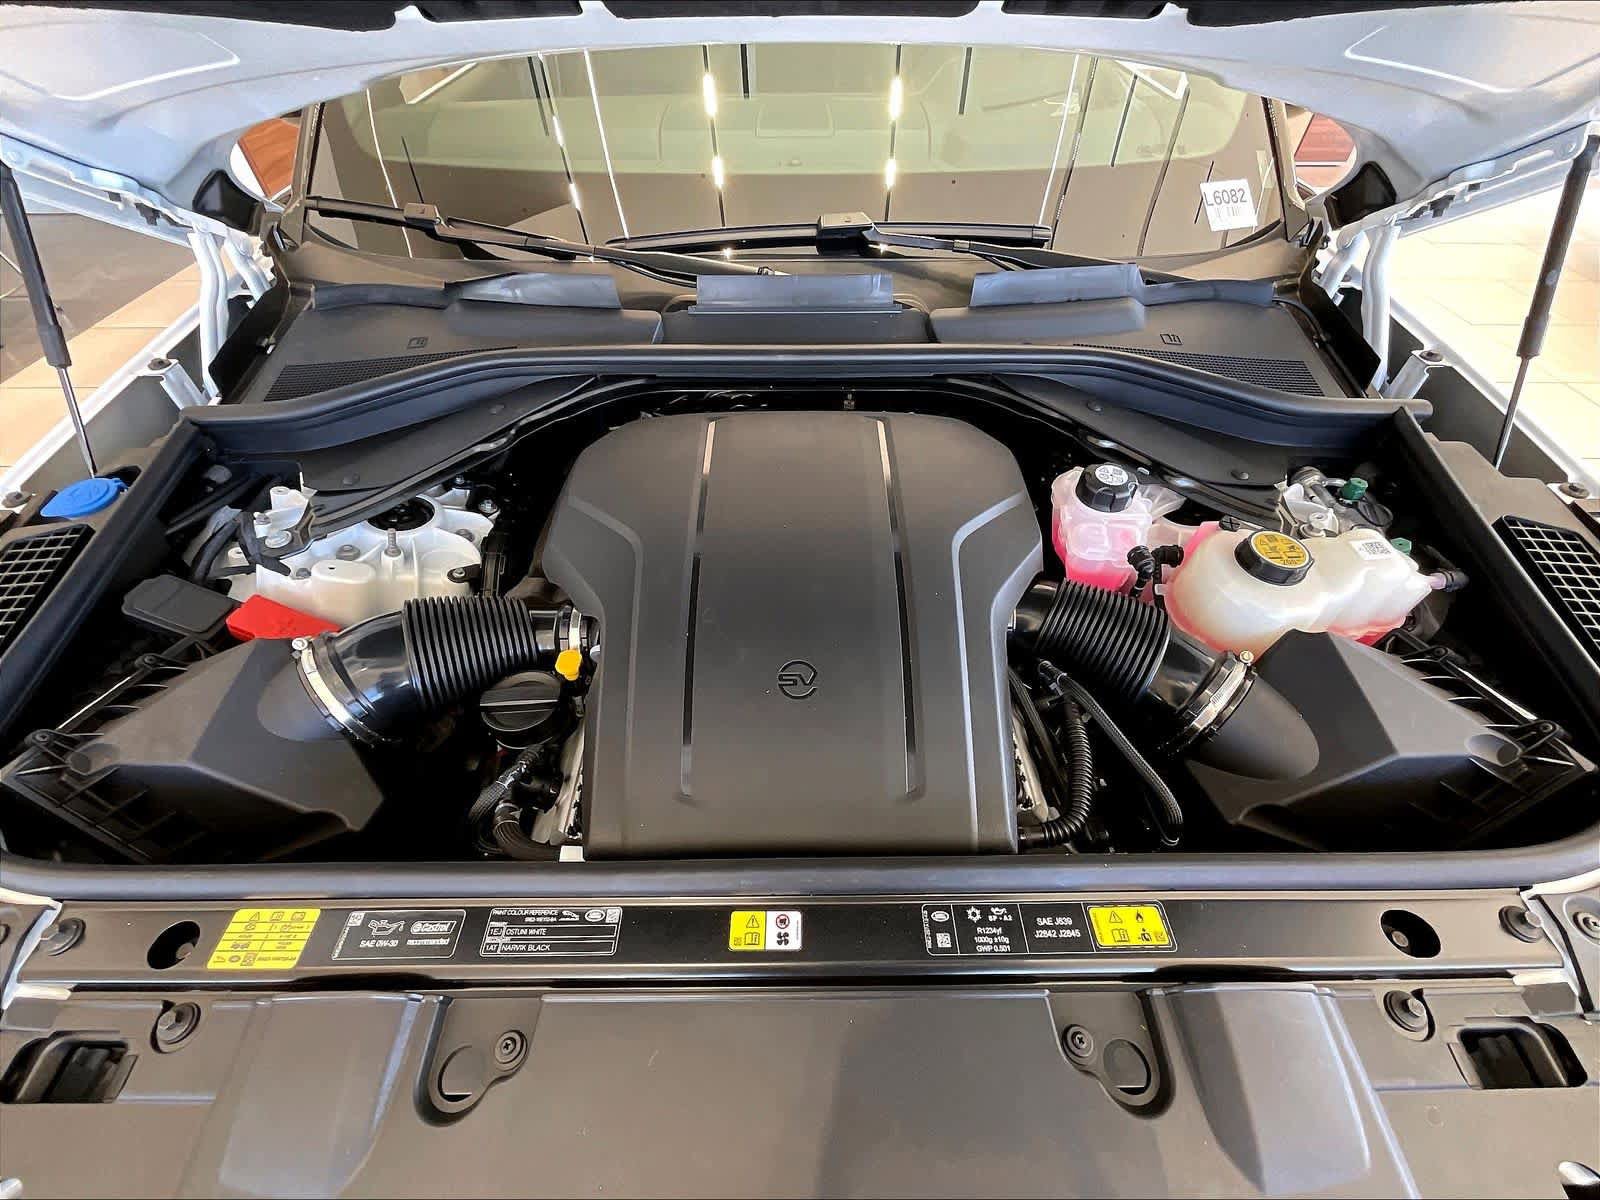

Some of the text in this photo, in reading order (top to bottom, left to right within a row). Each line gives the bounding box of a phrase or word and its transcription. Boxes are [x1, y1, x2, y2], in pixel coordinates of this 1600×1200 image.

[1203, 188, 1247, 206] L6082
[1036, 917, 1053, 926] SAE
[421, 921, 450, 931] Castrol
[976, 927, 1002, 935] R1234yf
[1034, 930, 1057, 938] J2842
[360, 939, 376, 947] SAE
[376, 939, 398, 947] 0W-30
[974, 936, 993, 944] 1000g
